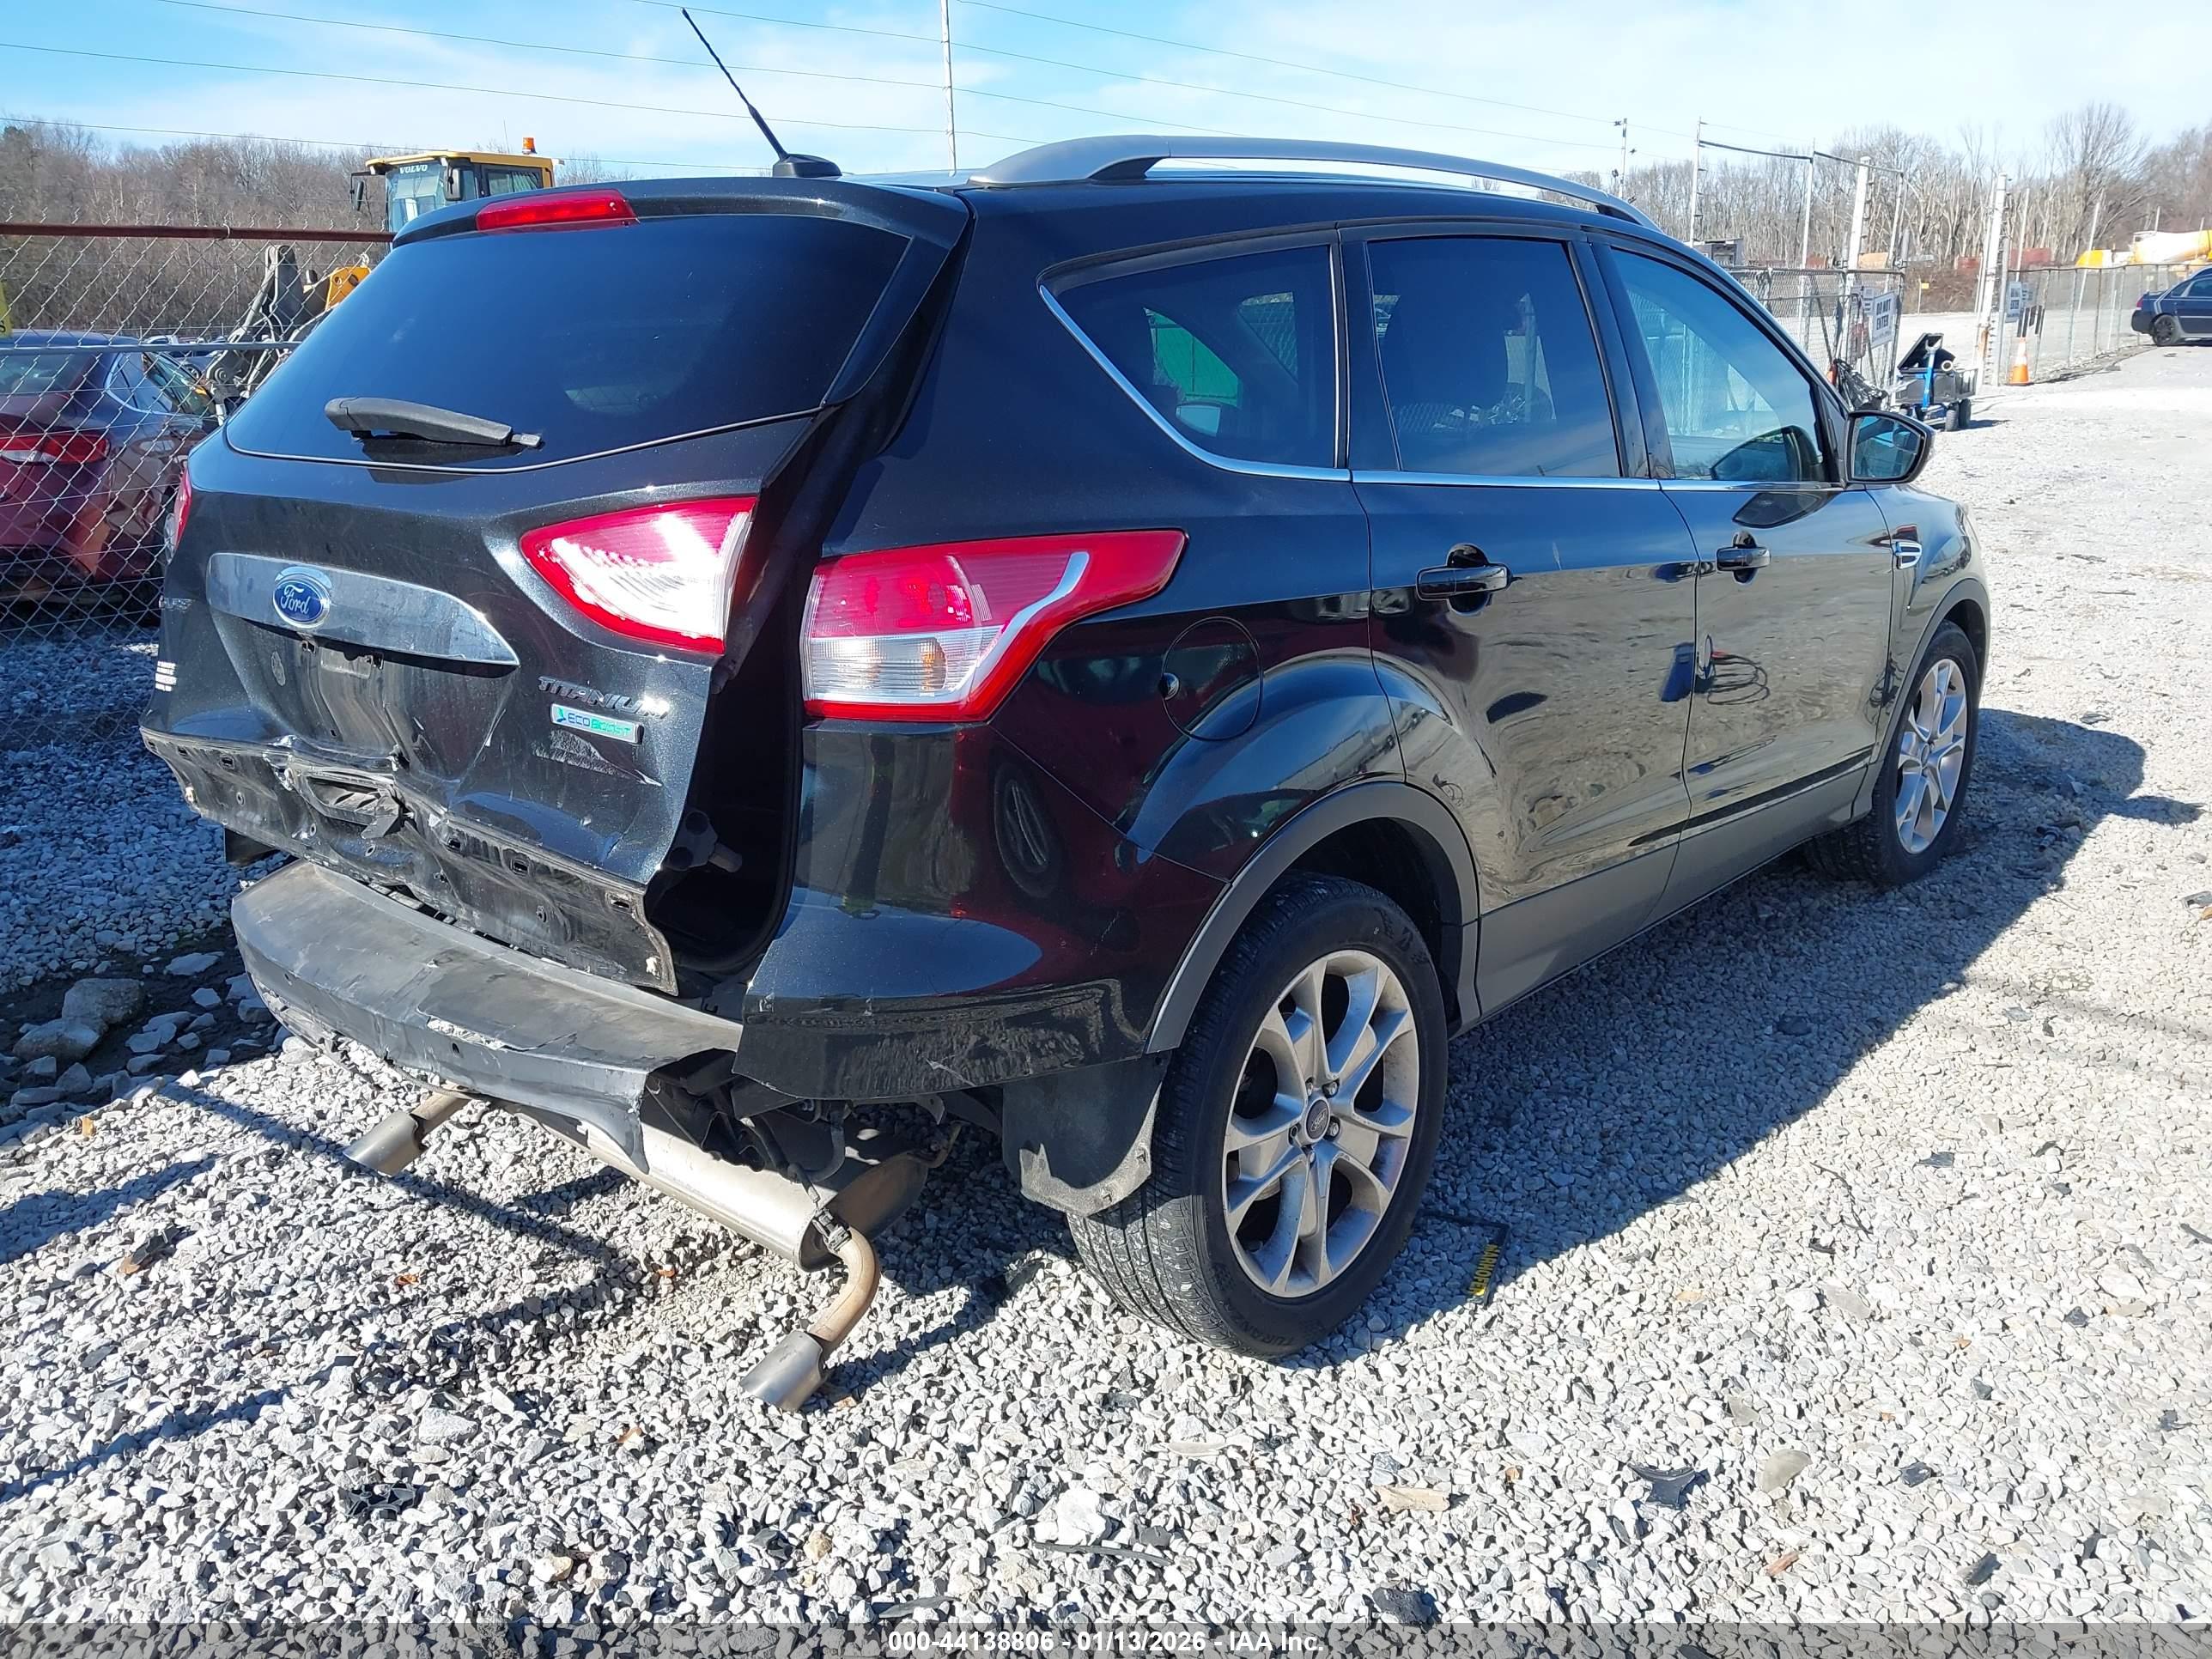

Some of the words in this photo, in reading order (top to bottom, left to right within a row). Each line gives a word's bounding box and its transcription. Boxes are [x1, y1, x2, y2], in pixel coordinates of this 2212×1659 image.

[399, 164, 428, 174] VOLVO
[280, 584, 312, 614] Ford
[538, 675, 670, 720] TITANIUM
